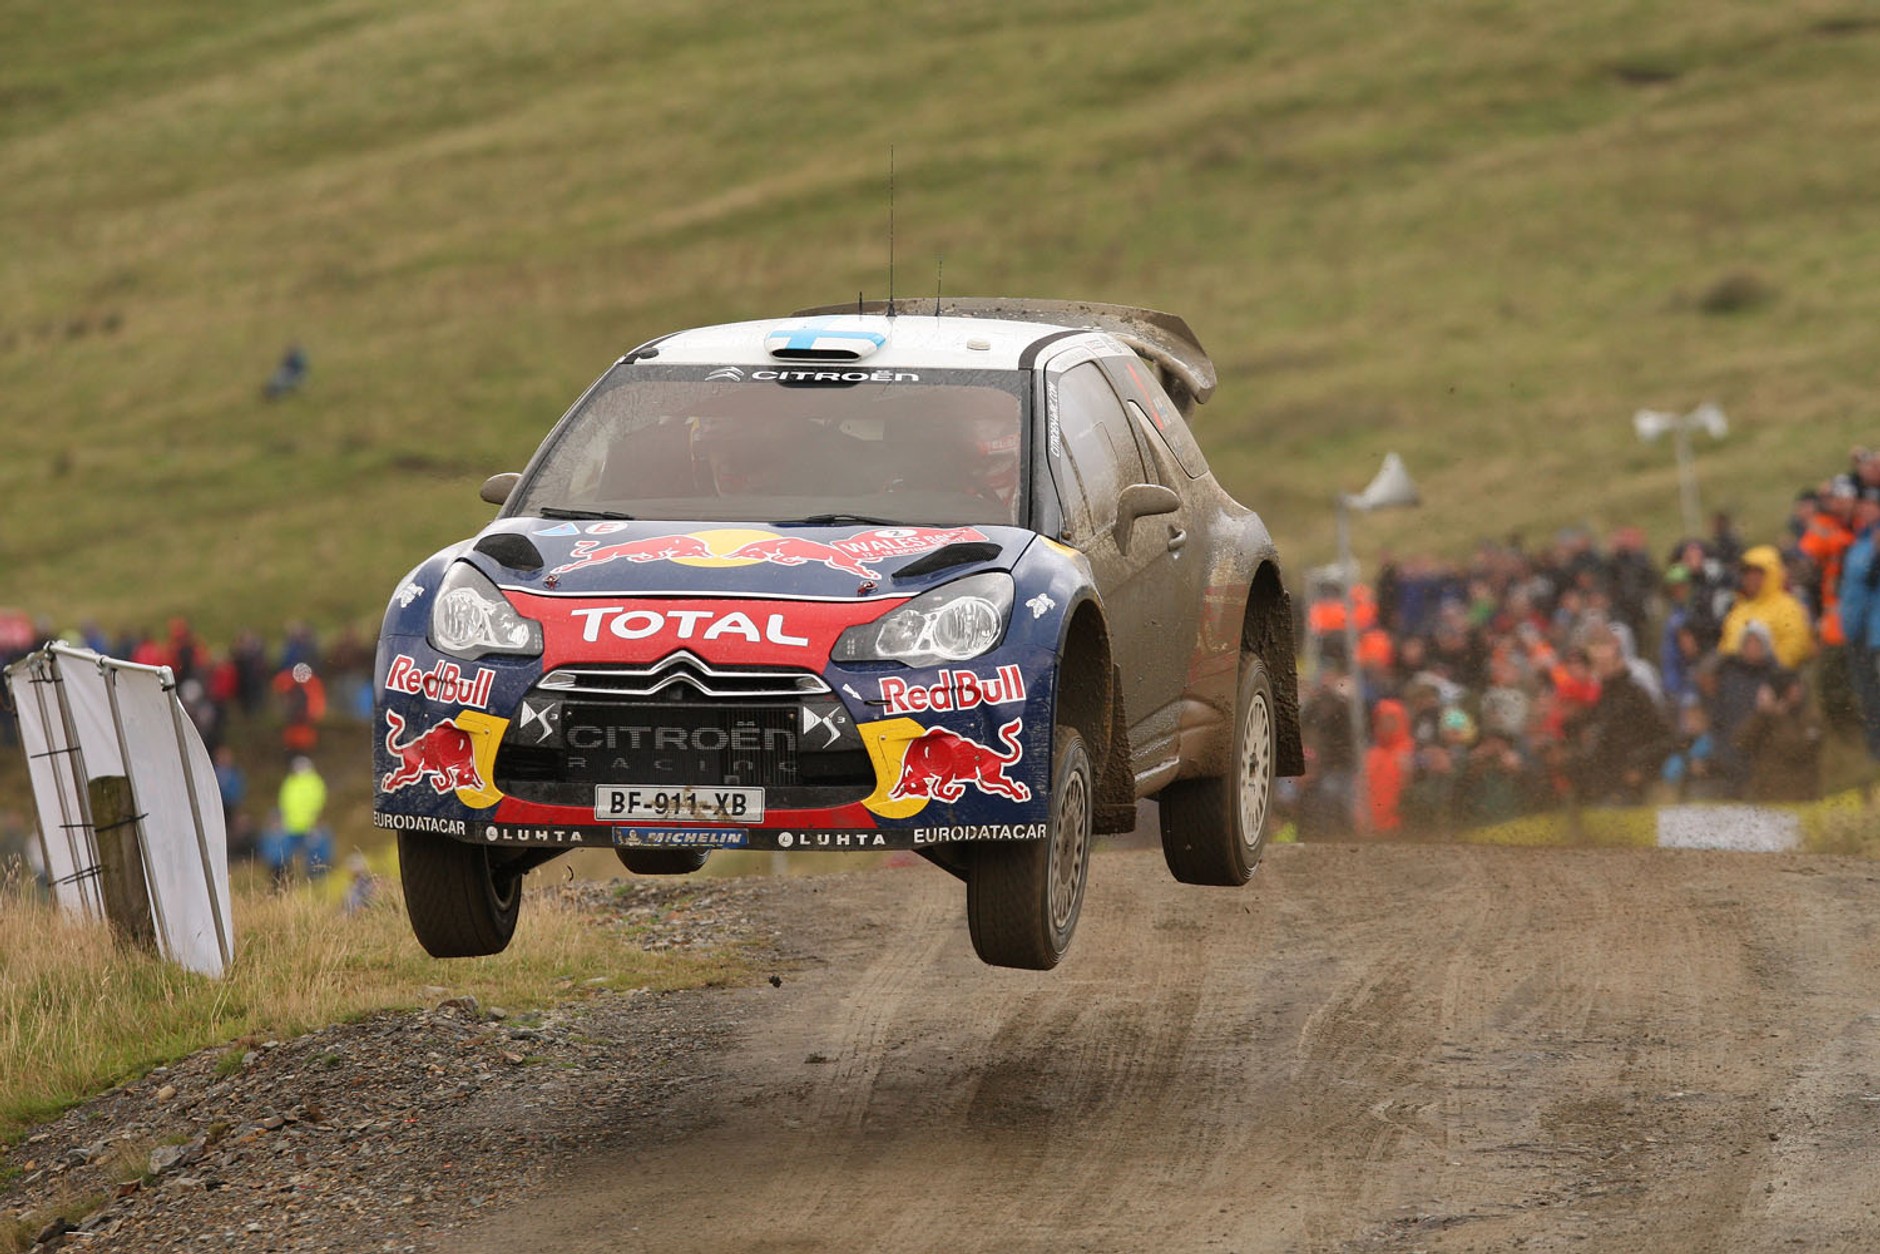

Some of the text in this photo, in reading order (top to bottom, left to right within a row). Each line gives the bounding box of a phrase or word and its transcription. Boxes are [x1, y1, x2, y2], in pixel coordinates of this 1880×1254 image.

[841, 535, 925, 553] WALES
[571, 607, 809, 647] TOTAL
[386, 654, 495, 708] Red Bull
[879, 664, 1026, 715] Red Bull
[610, 791, 747, 816] BF-911-XB
[374, 811, 466, 836] EURODATACAR
[913, 824, 1047, 844] EURODATACAR
[502, 829, 583, 842] LUHTA
[647, 832, 742, 844] MICHELIN
[800, 834, 886, 846] LUHTA
